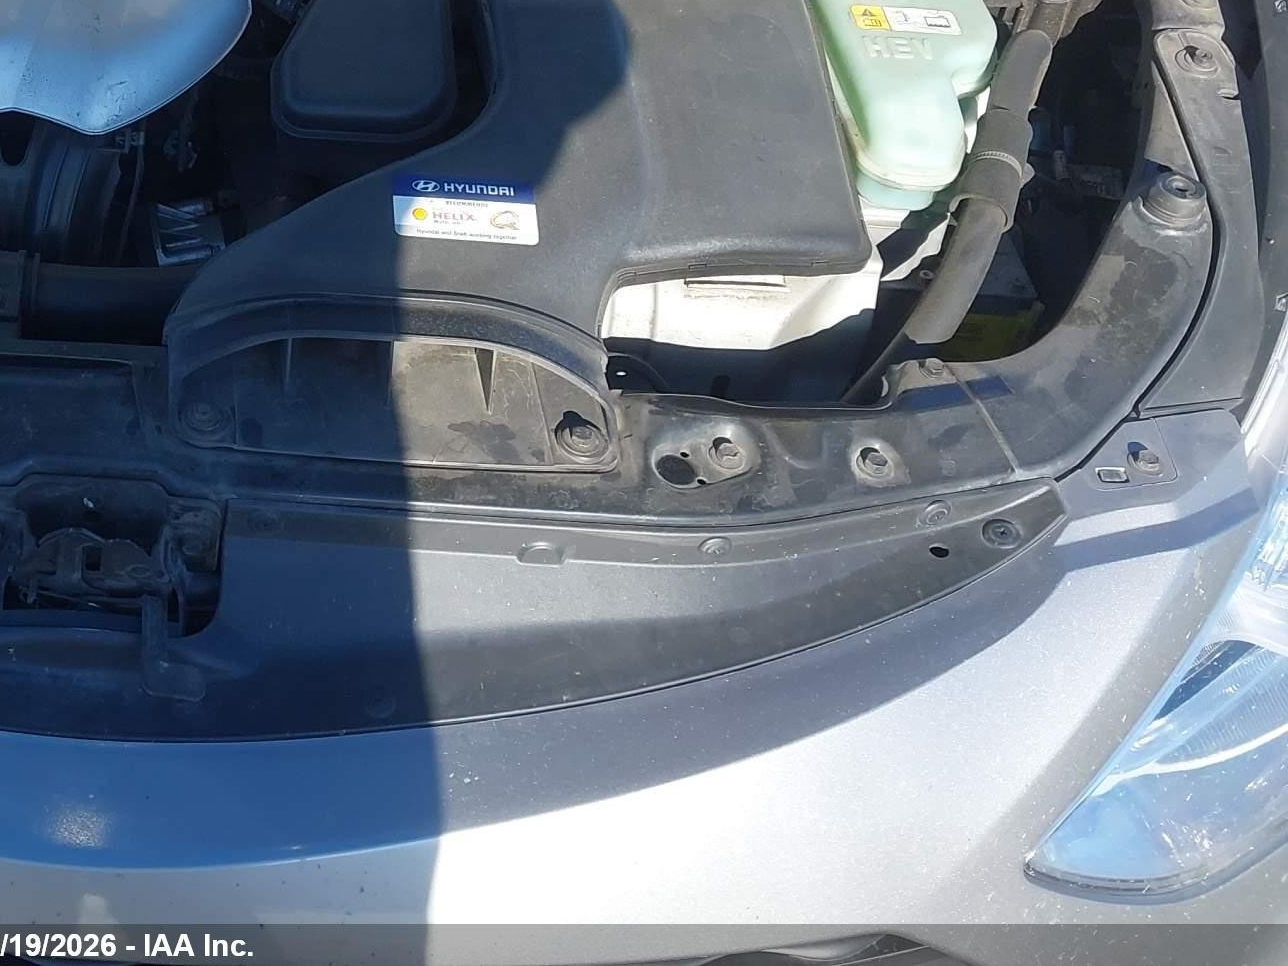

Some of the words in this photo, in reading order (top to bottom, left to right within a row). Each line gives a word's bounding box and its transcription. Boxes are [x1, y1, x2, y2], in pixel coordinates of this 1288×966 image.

[863, 35, 934, 60] HEV
[443, 182, 515, 197] HYUNDAI
[432, 211, 476, 221] HELIX
